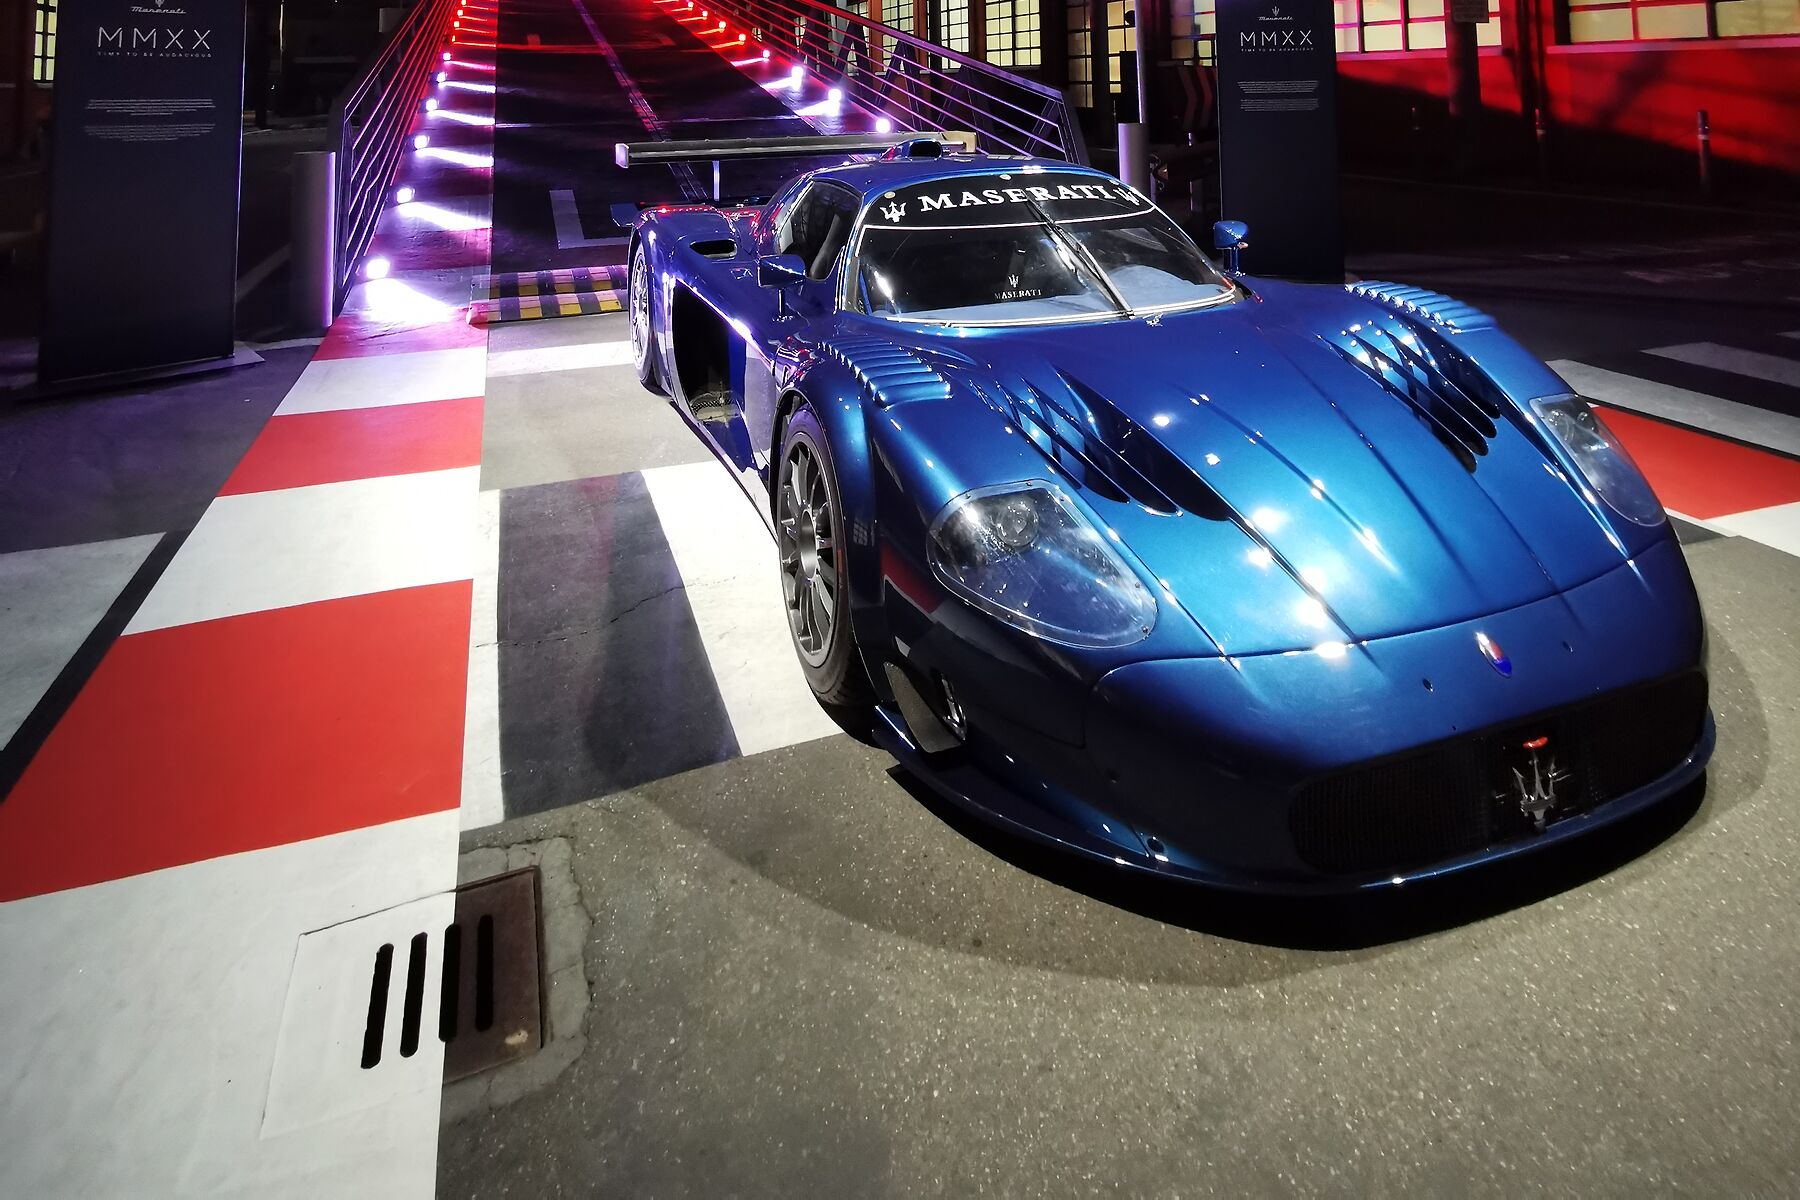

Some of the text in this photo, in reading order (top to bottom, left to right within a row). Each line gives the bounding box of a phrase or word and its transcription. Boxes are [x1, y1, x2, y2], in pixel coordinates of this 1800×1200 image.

[130, 6, 187, 14] Maserati
[98, 26, 211, 49] MMXX
[1240, 29, 1313, 47] MMXX
[917, 184, 1117, 212] MASERATI
